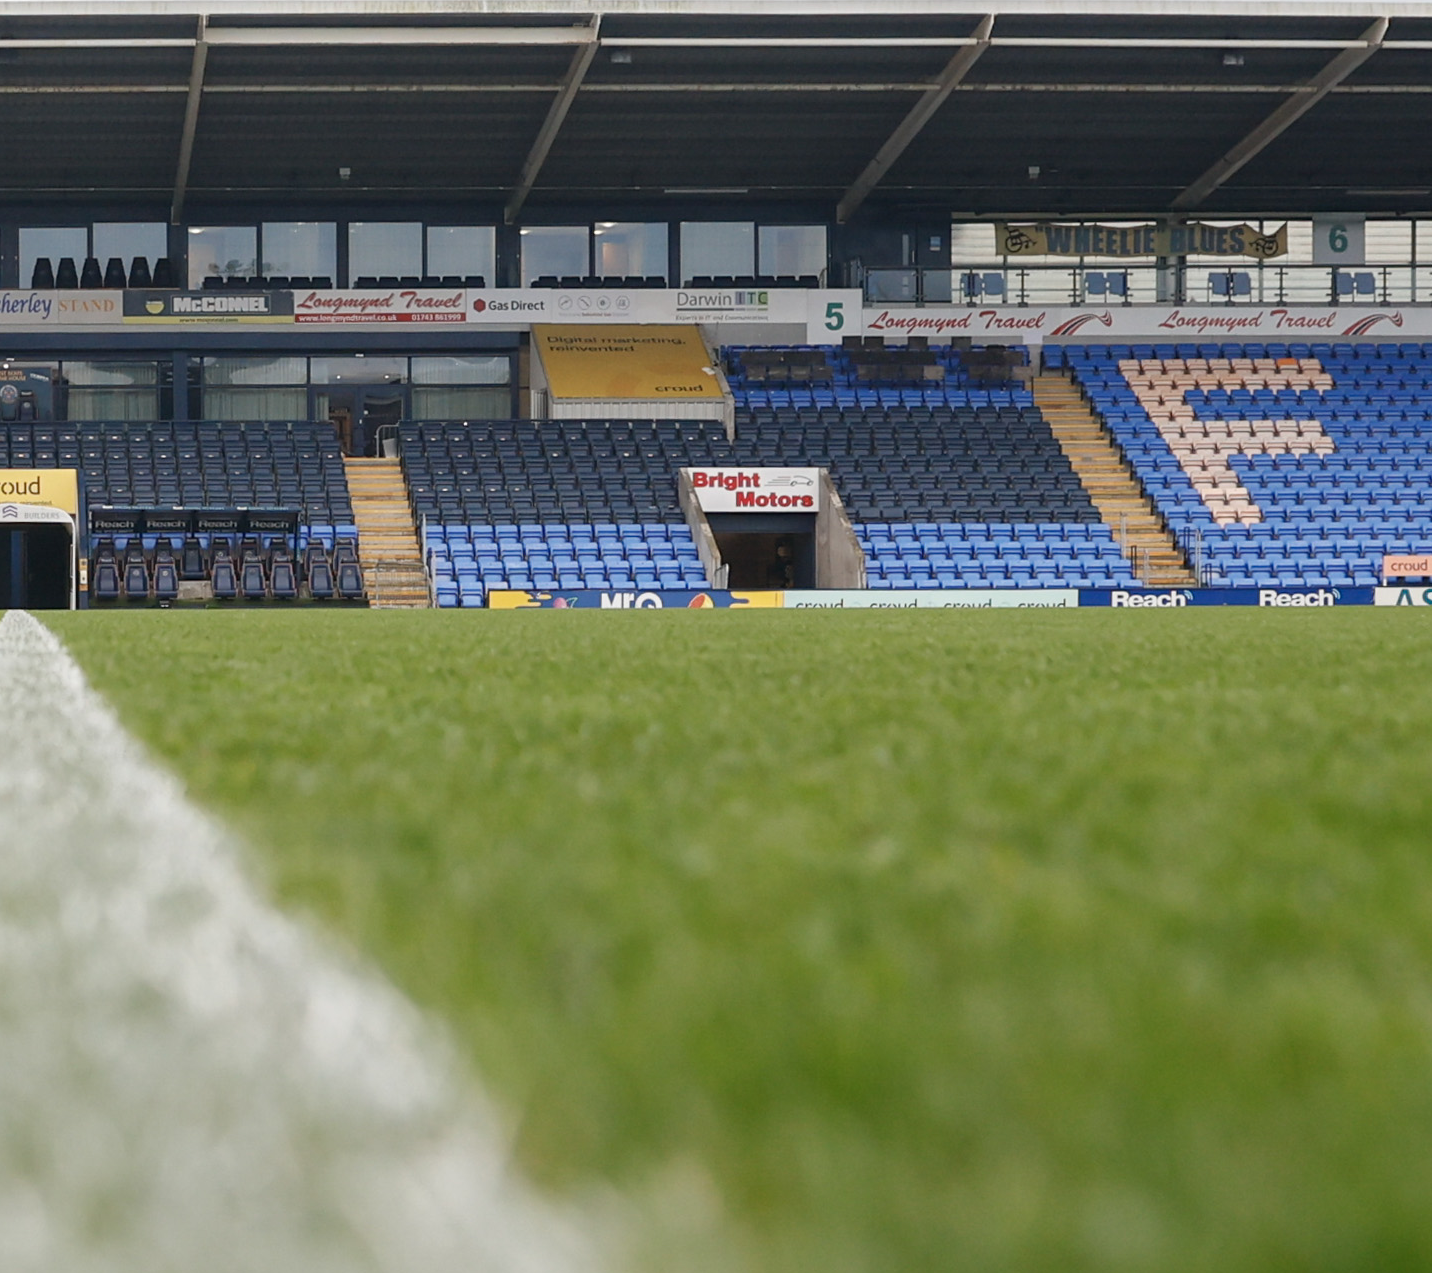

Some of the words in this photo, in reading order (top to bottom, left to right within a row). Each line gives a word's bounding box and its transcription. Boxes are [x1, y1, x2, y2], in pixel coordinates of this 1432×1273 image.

[1170, 226, 1245, 254] BLUES
[1328, 224, 1348, 253] 6
[59, 299, 115, 312] STAND
[297, 291, 394, 312] Longmynd
[399, 291, 463, 309] Travel
[488, 300, 509, 311] Gas
[511, 300, 545, 311] Direct
[677, 292, 732, 306] Darwin
[735, 291, 768, 305] ITC
[298, 314, 397, 323] www.longmyndtravel.co.uk
[825, 302, 844, 331] 5
[867, 311, 972, 334] Longmynd
[979, 310, 1046, 330] Travel
[1158, 310, 1264, 333] Longmynd
[1270, 309, 1337, 328] Travel
[547, 335, 597, 345] Digital
[655, 384, 703, 392] croud
[693, 472, 761, 490] Bright
[736, 492, 814, 507] Motors
[95, 520, 135, 529] Reach
[147, 520, 186, 529] Reach
[198, 520, 238, 529] Reach
[250, 520, 289, 529] Reach
[1391, 560, 1428, 571] croud
[1111, 591, 1185, 607] Reach
[1259, 589, 1334, 606] Reach
